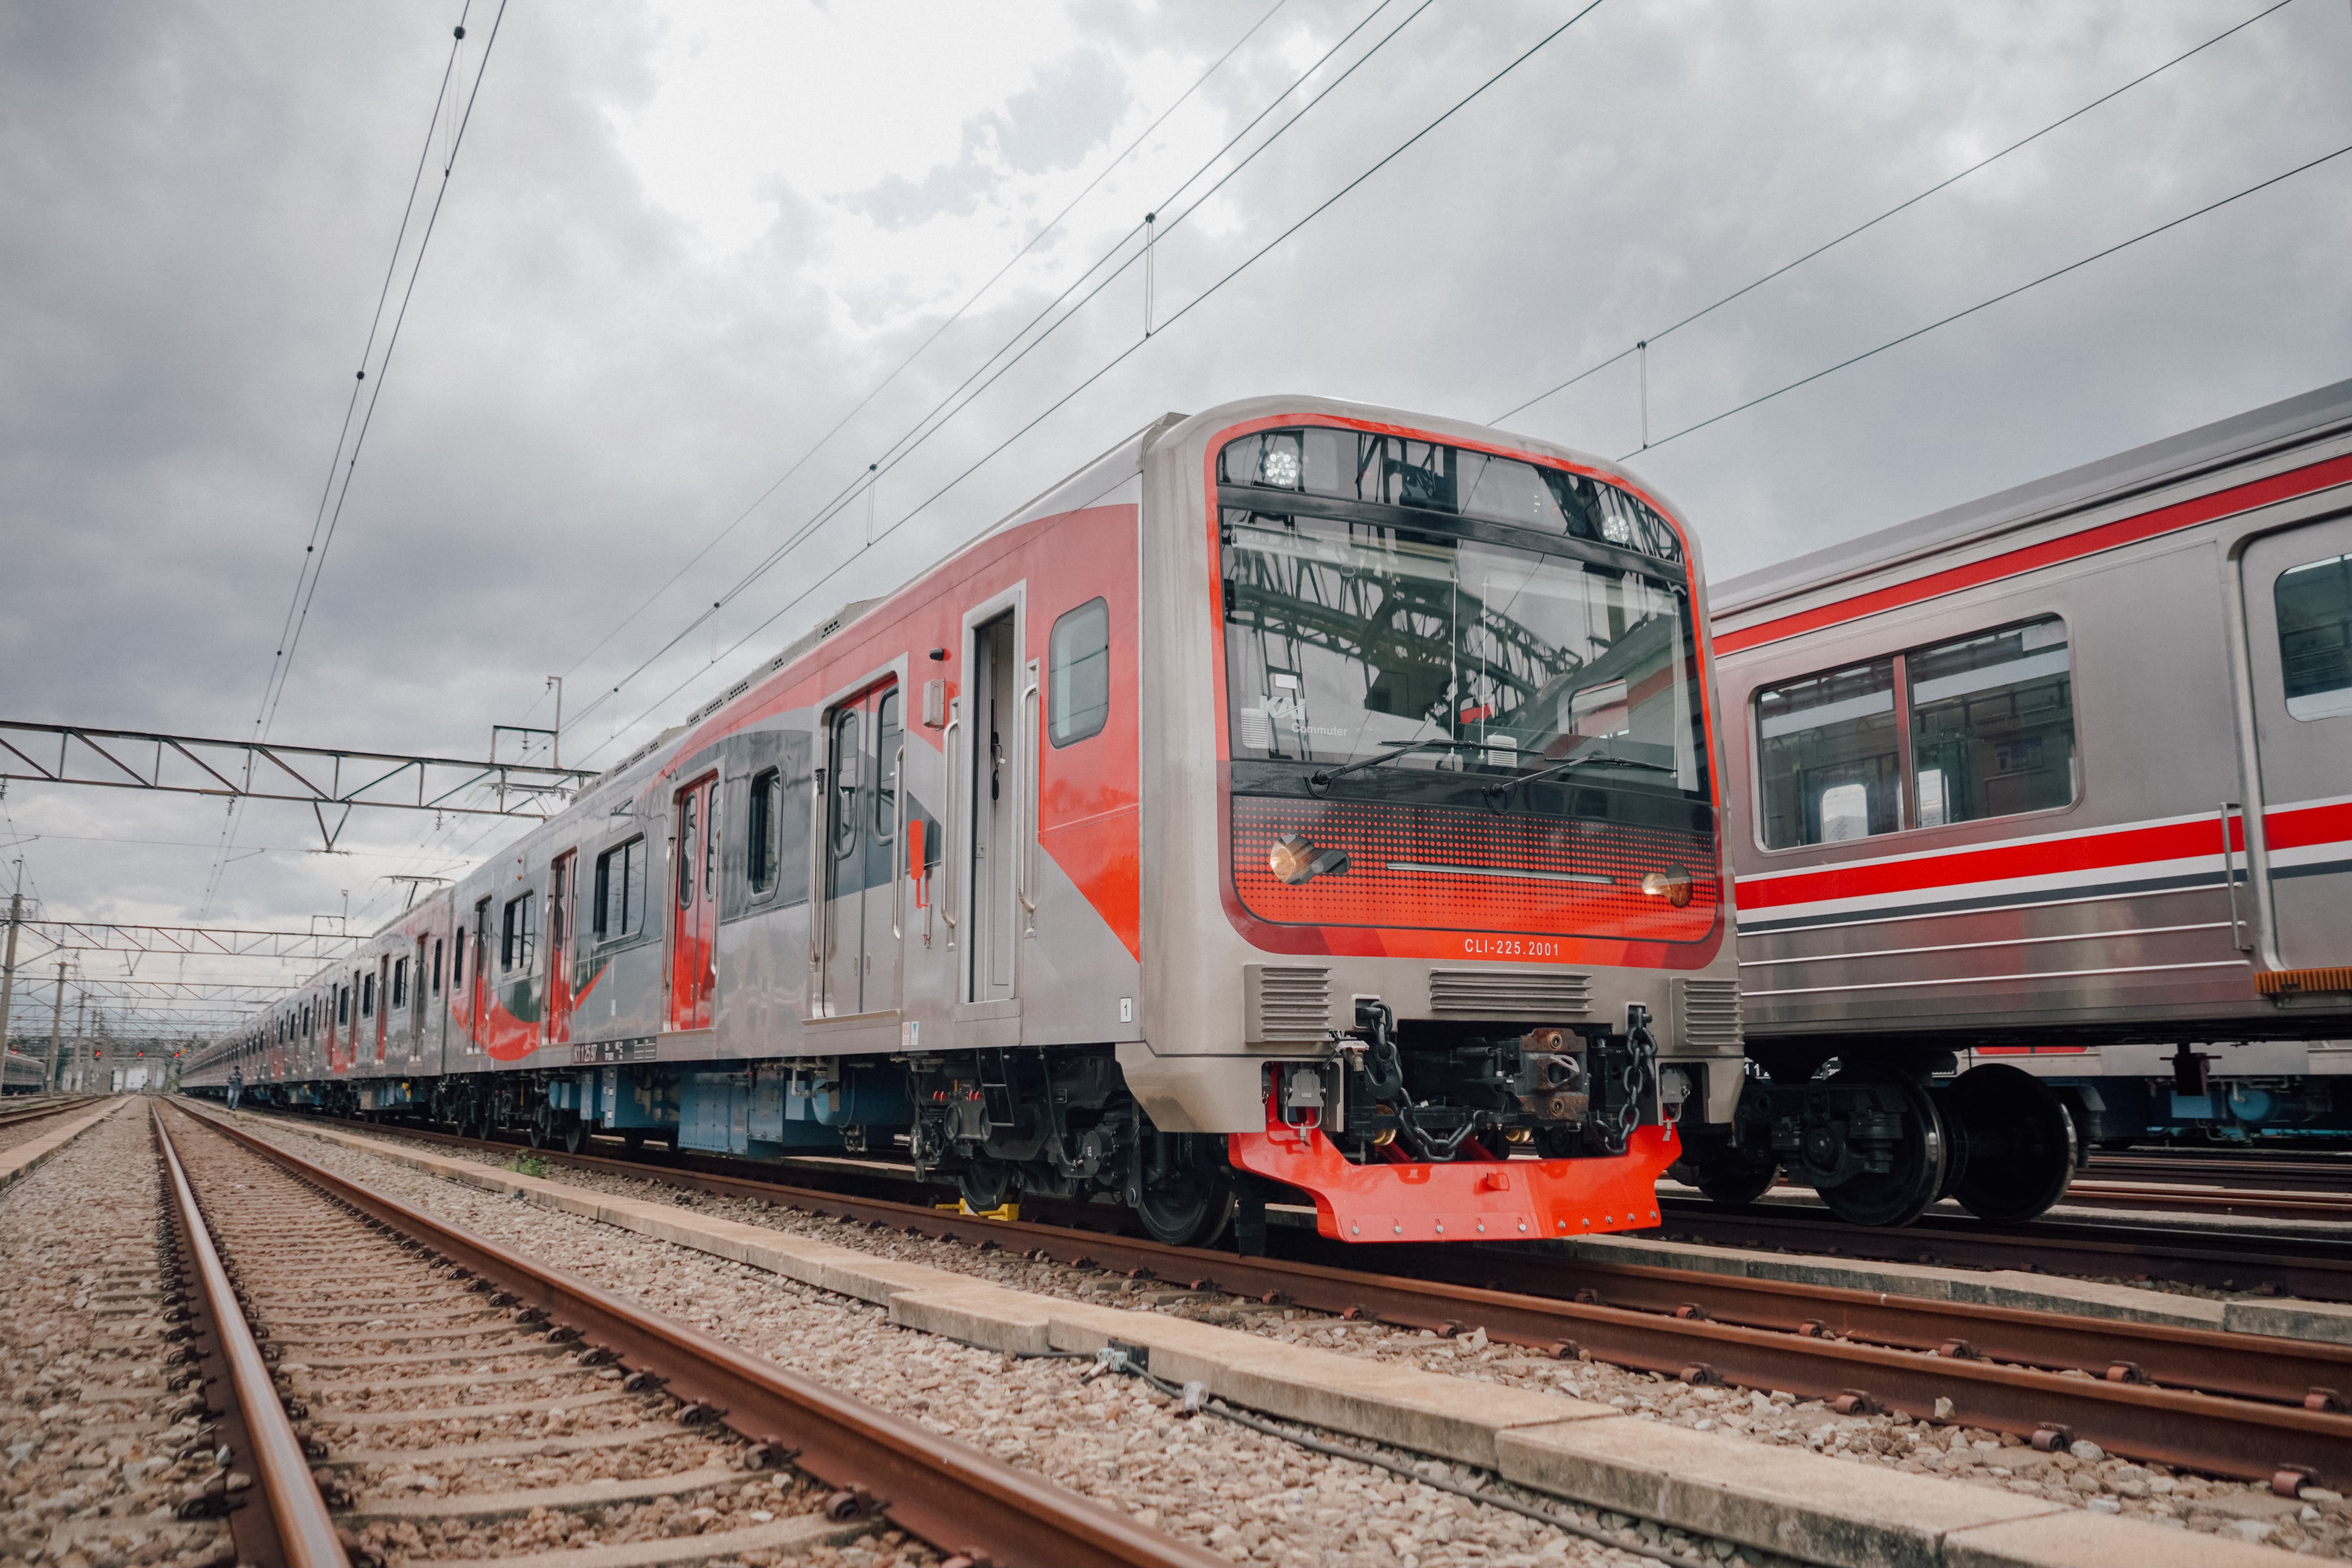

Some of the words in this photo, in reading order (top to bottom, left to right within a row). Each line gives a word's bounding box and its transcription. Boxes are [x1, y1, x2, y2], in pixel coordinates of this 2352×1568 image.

[1260, 696, 1305, 720] KAI
[1291, 722, 1347, 736] Commuter
[1465, 938, 1558, 956] CLI-225.2001
[1124, 1003, 1127, 1017] 1
